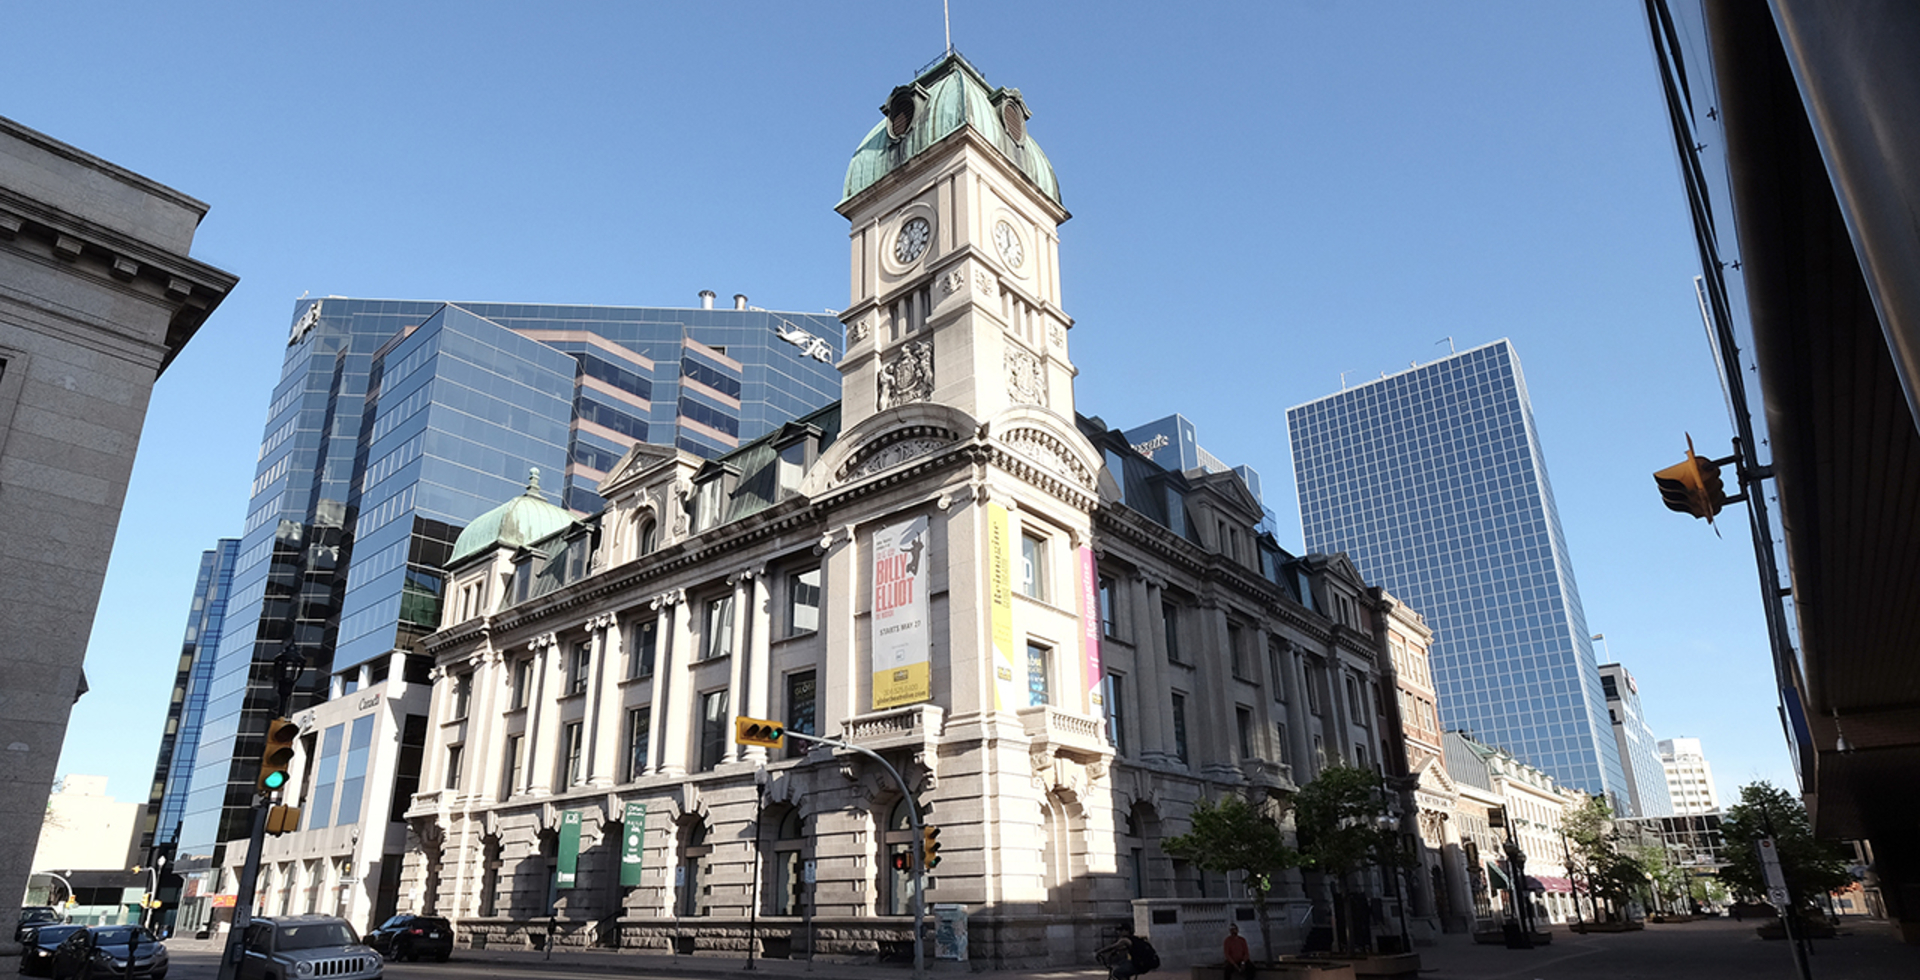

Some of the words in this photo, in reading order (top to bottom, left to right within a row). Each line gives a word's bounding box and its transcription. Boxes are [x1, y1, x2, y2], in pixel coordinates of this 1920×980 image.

[876, 553, 907, 586] BILLY
[875, 577, 914, 612] ELLIOT
[879, 624, 900, 636] STARTS
[901, 622, 913, 631] MAY
[358, 693, 381, 711] Canada
